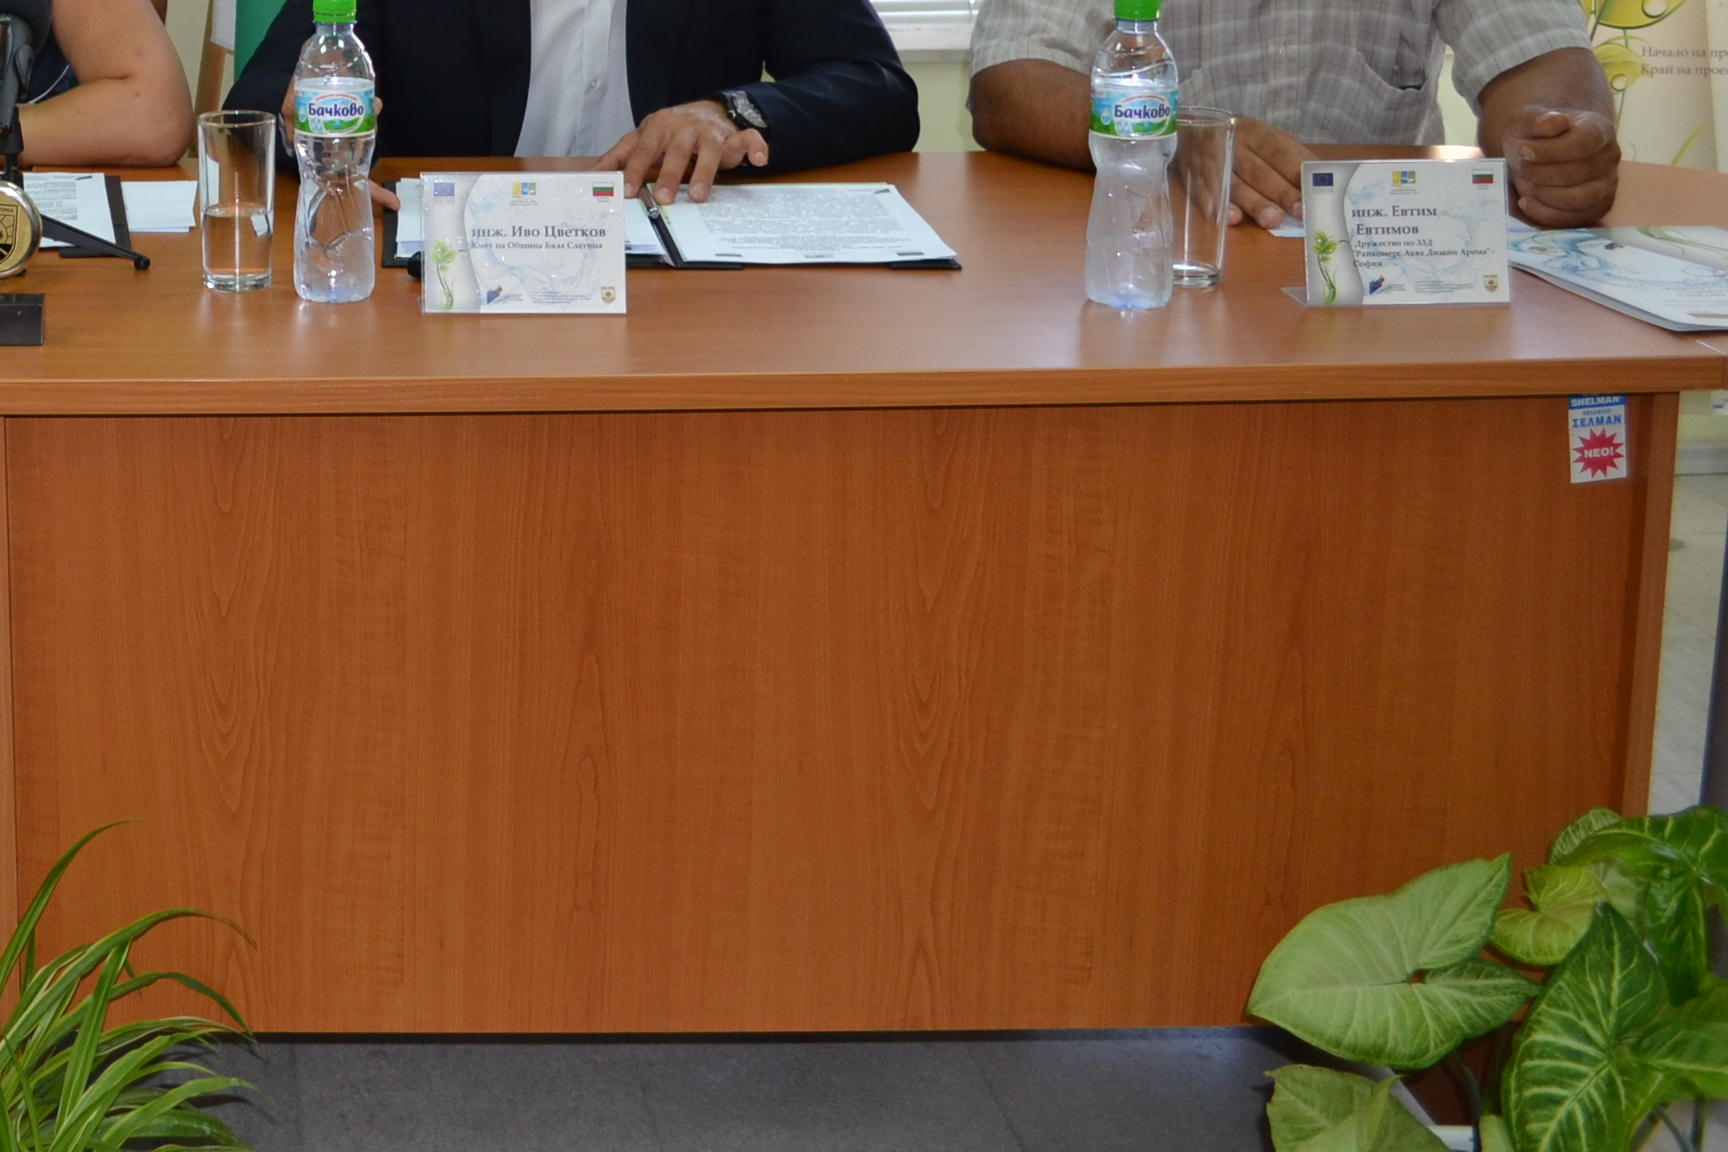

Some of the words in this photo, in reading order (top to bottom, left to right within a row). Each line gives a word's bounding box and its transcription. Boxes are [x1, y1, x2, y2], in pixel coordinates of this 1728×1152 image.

[1641, 46, 1689, 58] Начало
[1692, 48, 1707, 58] на
[1641, 63, 1673, 78] Край
[1676, 66, 1692, 76] на
[308, 101, 365, 117] Бачково
[1114, 103, 1171, 120] Бачково
[1352, 208, 1388, 218] инж.
[1391, 205, 1438, 217] Евтим
[471, 228, 508, 240] инж.
[511, 225, 541, 237] Иво
[544, 225, 607, 239] Цветков
[1356, 223, 1420, 236] Евтимов
[1571, 395, 1620, 407] SHELMAN
